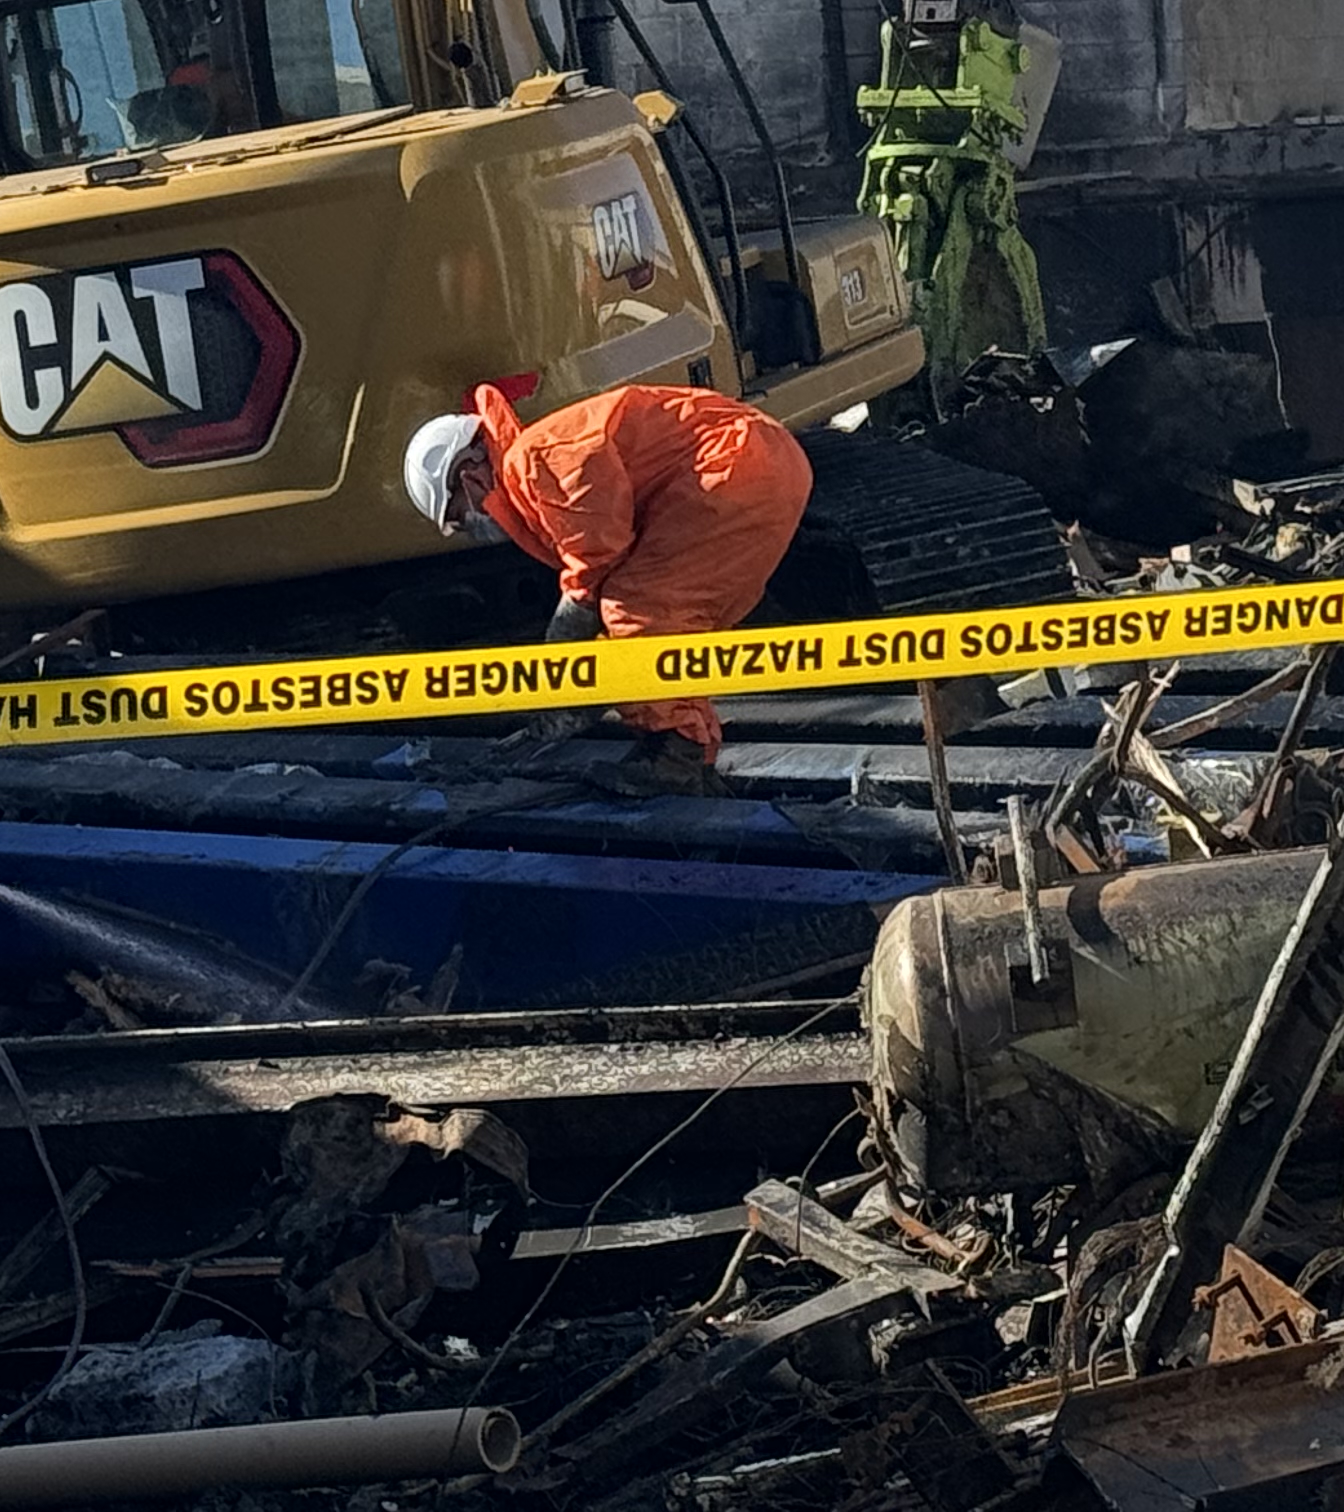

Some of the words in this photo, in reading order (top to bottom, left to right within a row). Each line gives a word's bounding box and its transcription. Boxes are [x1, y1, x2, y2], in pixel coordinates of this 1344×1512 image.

[594, 194, 642, 279] CAT
[961, 610, 1170, 657] ASBESTOS
[1185, 594, 1344, 637] DANGER
[656, 639, 822, 681] HAZARD
[839, 629, 944, 667] DUST
[185, 669, 408, 717] ASBESTOS
[426, 656, 596, 698] DANGER
[53, 686, 168, 727] DUST
